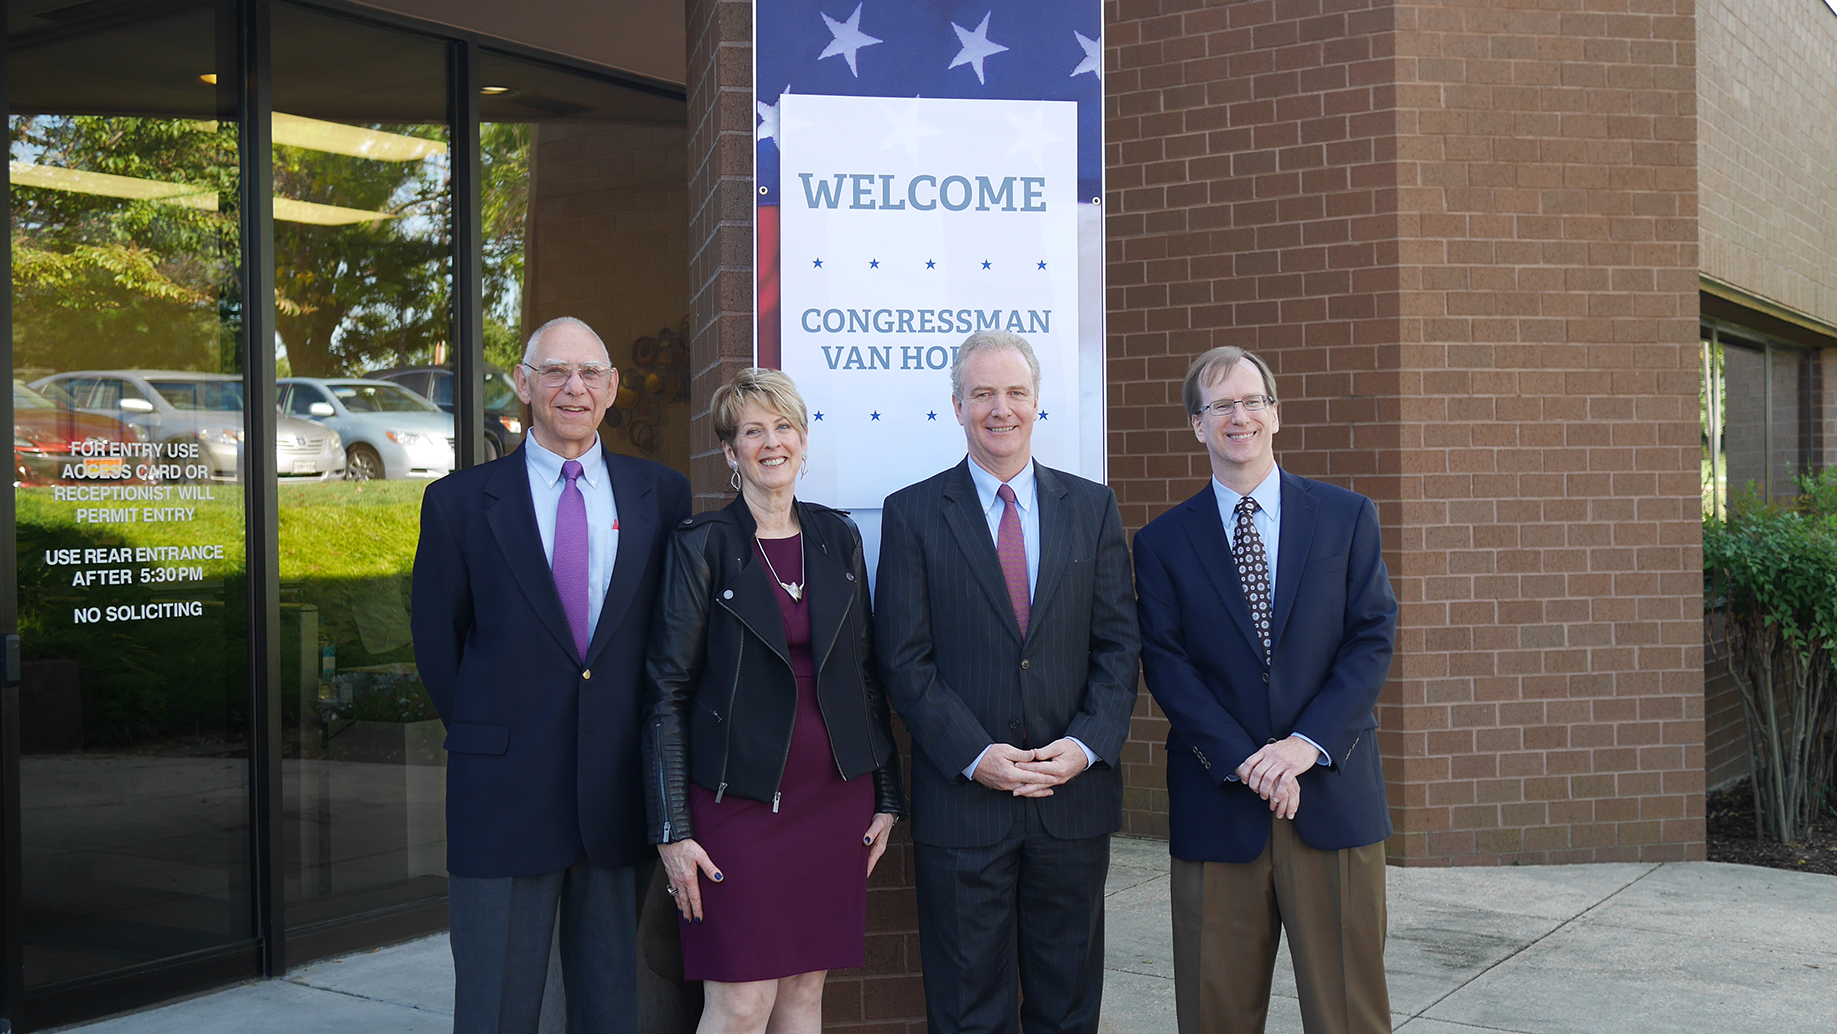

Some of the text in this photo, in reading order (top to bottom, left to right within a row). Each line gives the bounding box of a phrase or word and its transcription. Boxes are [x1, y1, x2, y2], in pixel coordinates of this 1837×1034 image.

[798, 172, 1047, 212] WELCOME
[801, 308, 1052, 334] CONGRESSMAN
[821, 346, 893, 370] VAN
[70, 441, 199, 458] FOR ENTRY USE
[62, 464, 132, 479] ACCESS
[135, 464, 182, 479] CARD
[185, 464, 208, 479] OR
[54, 486, 215, 501] RECEPTIONIST WILL
[76, 507, 195, 523] PERMIT ENTRY
[45, 545, 224, 566] USE REAR ENTRANCE
[72, 569, 132, 587] AFTER
[74, 601, 203, 624] NO SOLICITING
